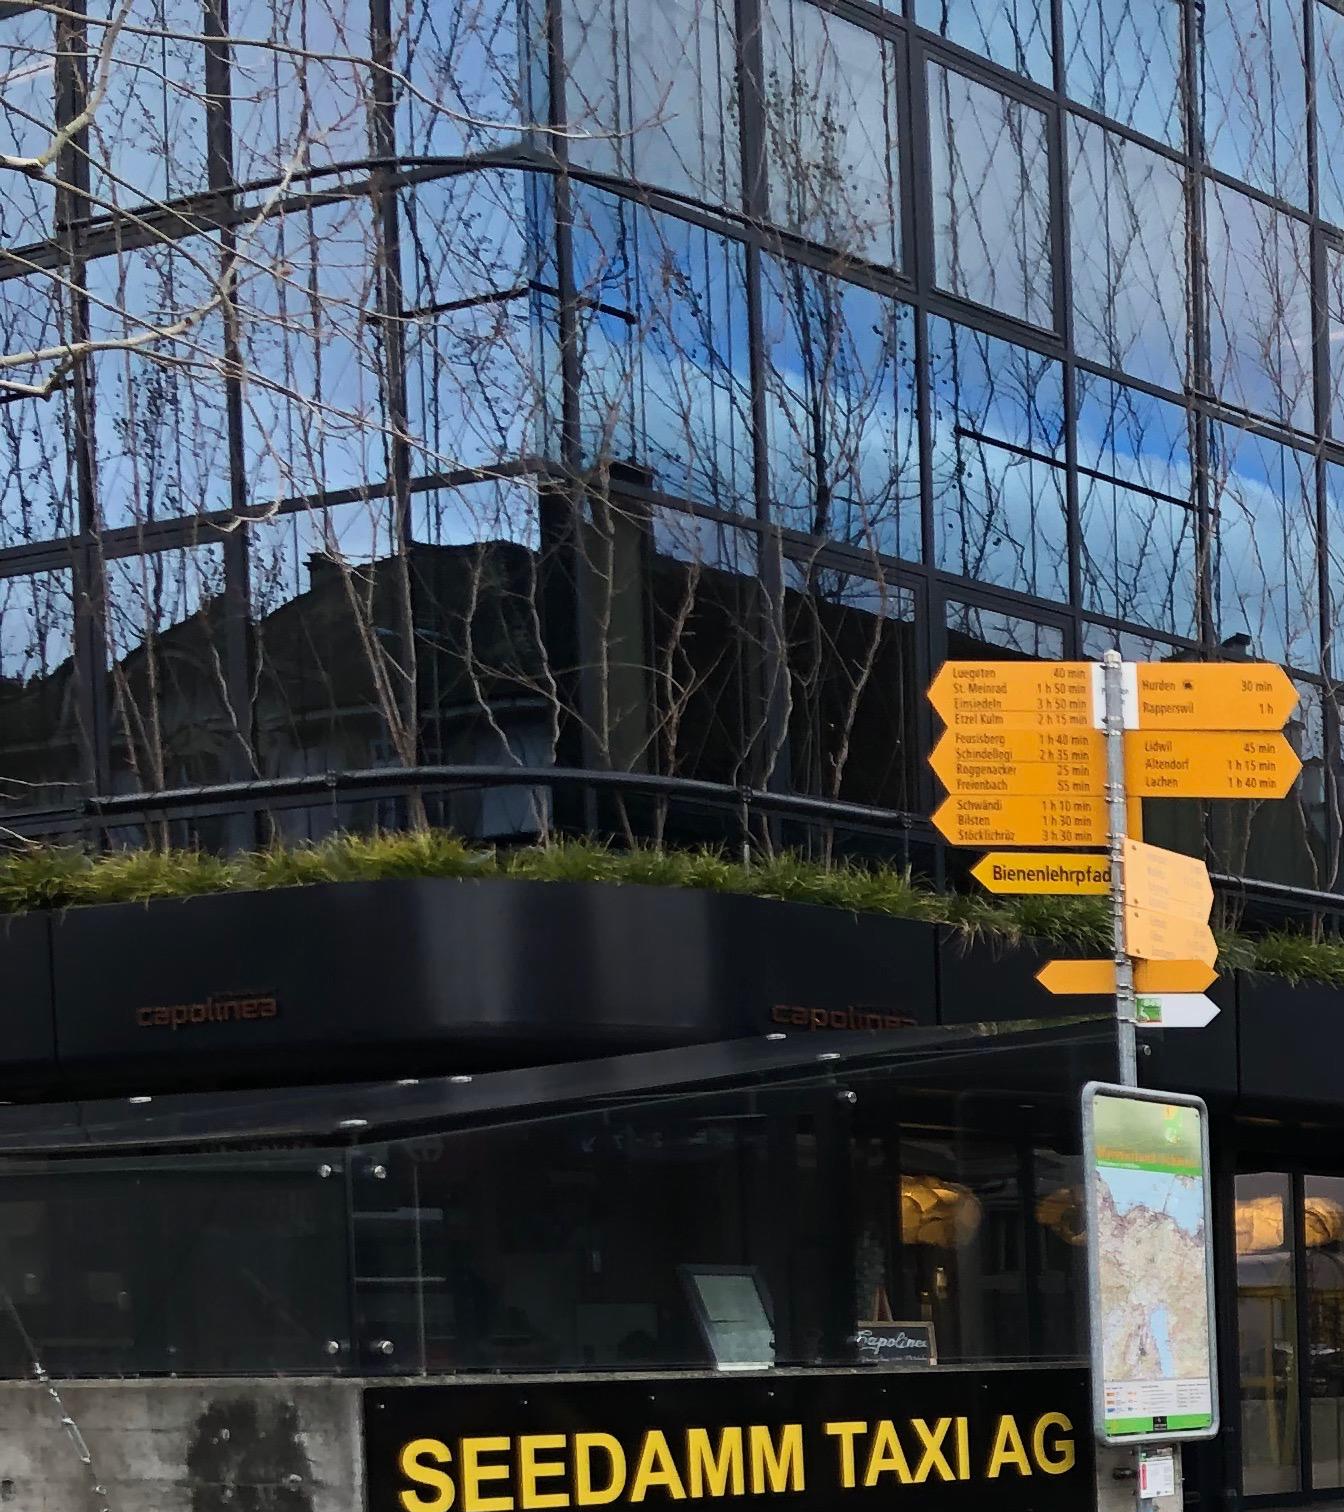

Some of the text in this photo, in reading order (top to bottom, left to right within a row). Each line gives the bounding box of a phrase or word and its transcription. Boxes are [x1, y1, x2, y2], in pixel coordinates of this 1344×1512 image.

[1067, 668, 1086, 679] min
[953, 684, 967, 694] St.
[968, 684, 1007, 694] Meinrad
[1068, 684, 1086, 695] min
[1142, 680, 1273, 691] Hurden 30 min
[954, 699, 1002, 709] Einsiedeln
[1069, 699, 1087, 710] min
[1143, 702, 1194, 717] Rapperswil
[955, 714, 978, 725] Etzel
[980, 714, 1003, 725] Kulm
[1069, 715, 1088, 725] min
[1071, 736, 1089, 746] min
[1243, 743, 1256, 754] 45
[1258, 743, 1276, 754] min
[1072, 751, 1090, 761] min
[1145, 759, 1190, 771] Altendorf
[1258, 761, 1276, 771] min
[1072, 766, 1090, 776] min
[1073, 781, 1090, 791] min
[1146, 776, 1179, 788] Lachen
[1259, 778, 1277, 788] min
[1073, 801, 1092, 811] min
[1074, 816, 1092, 826] min
[1075, 832, 1092, 842] min
[993, 865, 1112, 886] Bienenlehrpfad
[136, 997, 277, 1031] capolinea
[825, 1416, 971, 1489] TAXI
[987, 1411, 1075, 1479] AG
